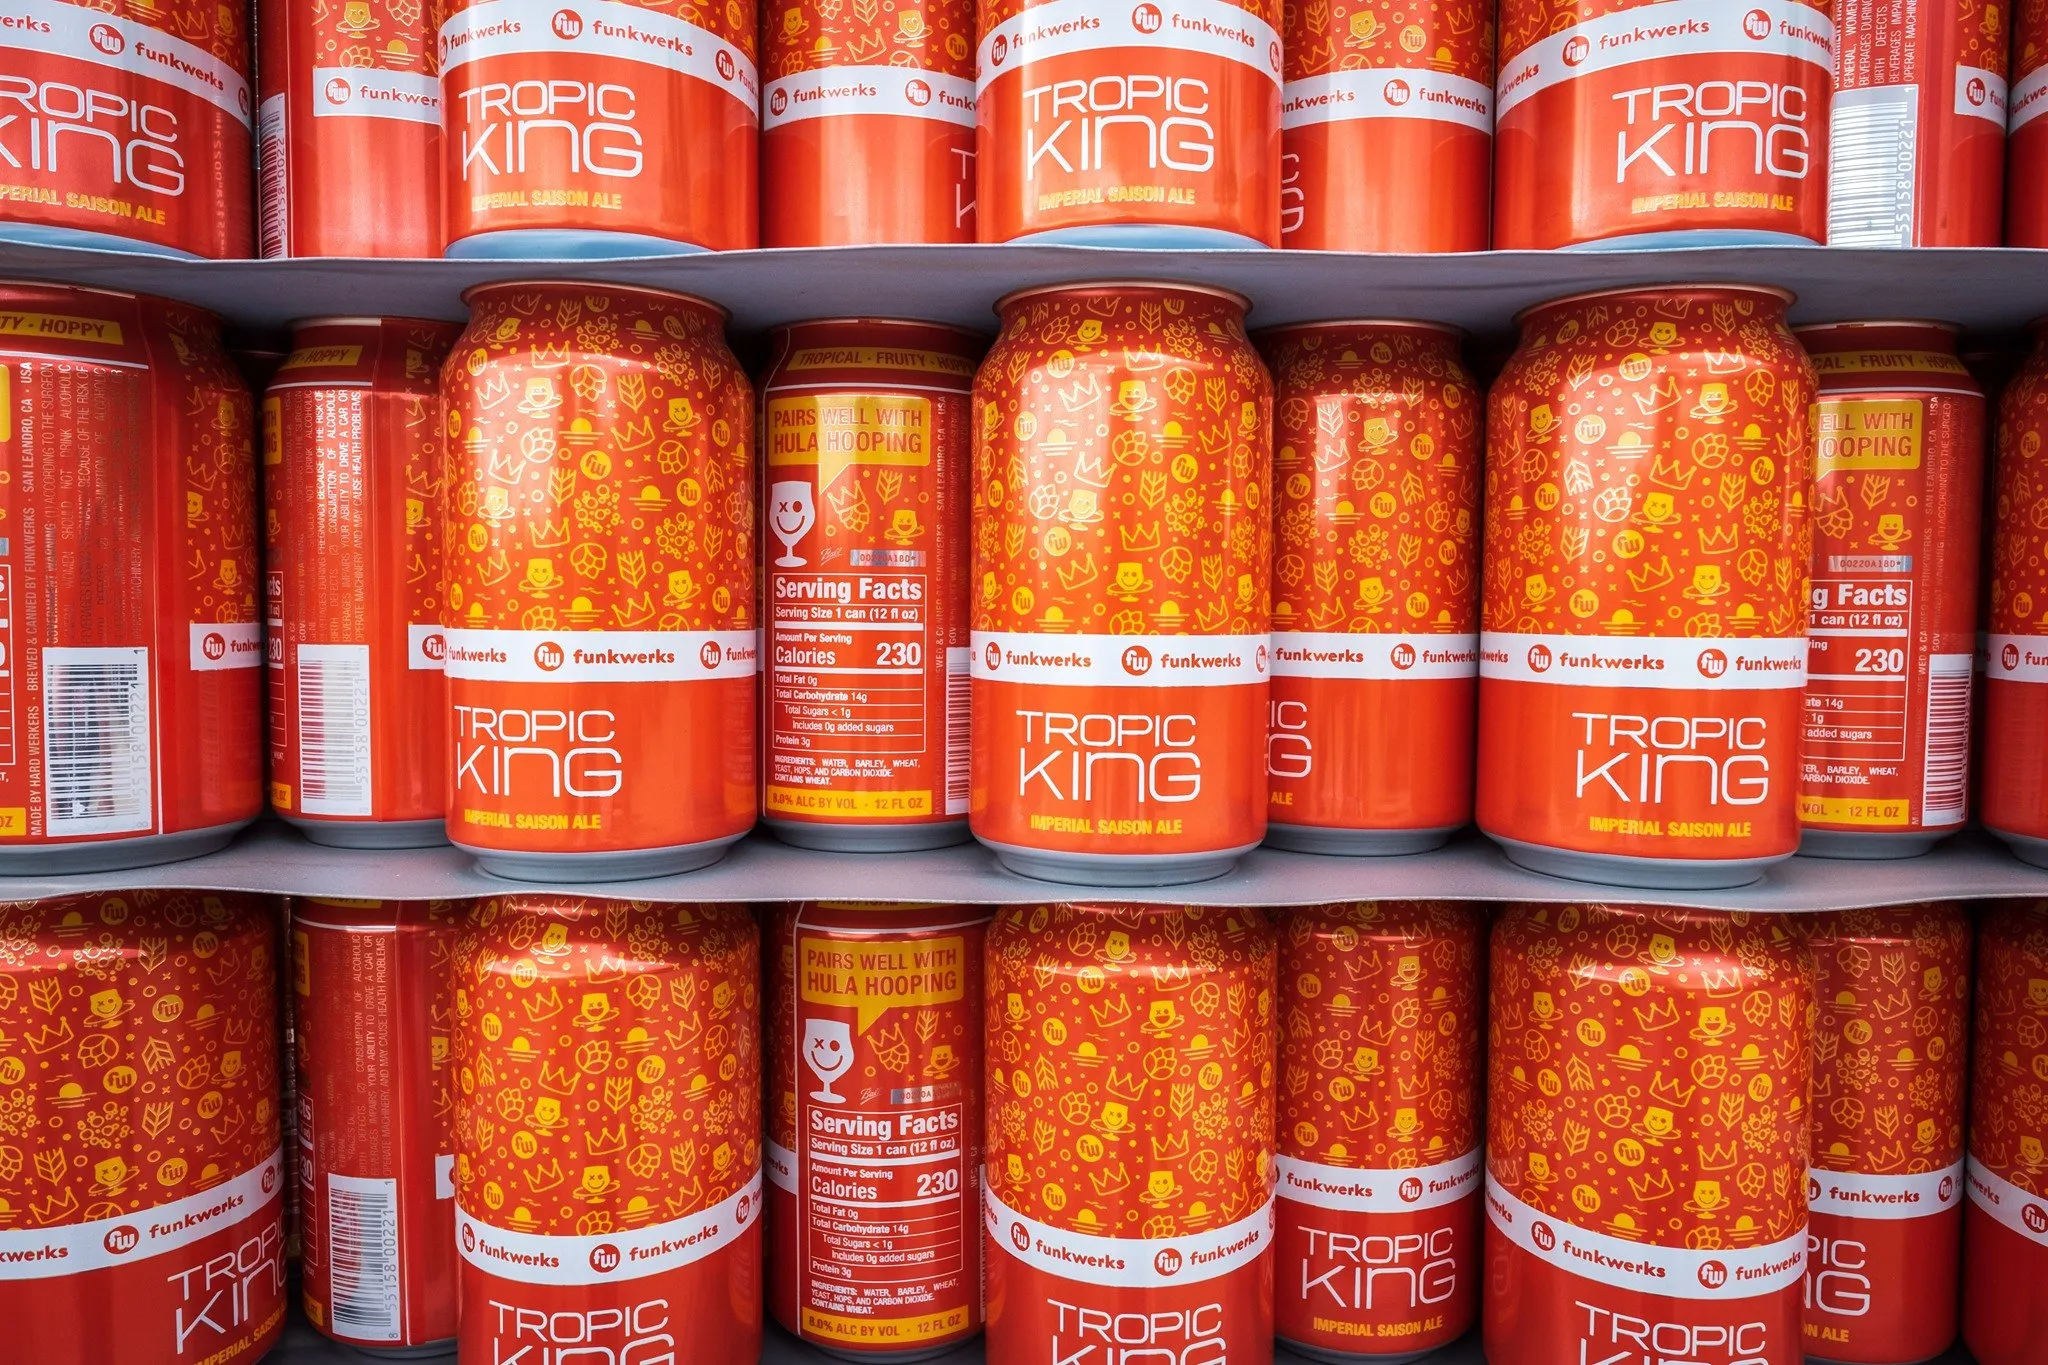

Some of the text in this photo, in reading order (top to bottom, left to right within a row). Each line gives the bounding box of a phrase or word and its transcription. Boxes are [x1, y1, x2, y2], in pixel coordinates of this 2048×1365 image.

[593, 20, 693, 56] funkwerks
[1171, 13, 1255, 47] funkwerks
[1599, 19, 1710, 50] funkwerks
[1874, 4, 1887, 83] BIRTH DEFECTS.
[135, 41, 224, 91] funkwerks
[1859, 34, 1871, 85] BEVERAGES
[1889, 30, 1901, 82] BEVERAGES
[1905, 42, 1915, 81] OPERATE
[459, 80, 635, 123] TROPIC
[793, 83, 877, 102] funkwerks
[1023, 75, 1208, 122] TROPIC
[1419, 88, 1487, 115] funkwerks
[1612, 81, 1806, 124] TROPIC
[800, 351, 925, 367] TROPICAL FRUITY
[1860, 355, 1914, 367] FRUITY
[774, 408, 922, 428] PAIRS WELL WITH
[1864, 413, 1913, 430] WITH
[774, 431, 922, 453] HULA HOOPING
[339, 442, 349, 467] DRIVE
[352, 442, 362, 475] HEALTH
[20, 362, 36, 572] FUNKWERKS SAN LEANDRO, CA USA
[776, 577, 922, 603] Serving Facts
[1838, 584, 1907, 606] Facts
[776, 606, 918, 621] Serving Size 1 can (12 fl oz)
[776, 633, 852, 644] Amount Per Serving
[573, 649, 675, 665] funkwerks
[776, 642, 921, 665] Calories 230
[1161, 653, 1241, 669] funkwerks
[1276, 648, 1364, 663] funkwerks
[1560, 653, 1664, 669] funkwerks
[1736, 655, 1801, 671] funkwerks
[1855, 649, 1903, 672] 230
[776, 674, 818, 686] Total Fat 0g
[776, 689, 867, 703] Total Carbohydrate 14g
[785, 705, 851, 718] Total Sugars 1g
[455, 706, 615, 742] TROPIC
[792, 720, 894, 733] Includes 0g added sugars
[1016, 710, 1196, 747] TROPIC
[1572, 713, 1766, 749] TROPIC
[1808, 729, 1872, 740] added sugars
[27, 647, 42, 835] MADE BY HARD WERKERS BREWED
[776, 735, 810, 747] Protein 3g
[775, 755, 920, 768] INGREDIENTS: WATER, BARLEY, WHEAT,
[775, 765, 793, 774] YEAST,
[815, 767, 829, 775] AND
[831, 768, 860, 777] CARBON
[862, 768, 894, 777] DIOXIDE.
[775, 774, 832, 785] CONTAINS WHEAT.
[773, 794, 923, 809] 8.0% ALC BY VOL 12 FL OZ
[1271, 793, 1293, 805] ALE
[516, 814, 601, 829] SAISON ALE
[1031, 815, 1182, 835] IMPERIAL SAISON ALE
[1590, 817, 1751, 837] IMPERIAL SAISON ALE
[807, 949, 957, 970] PAIRS WELL WITH
[376, 935, 386, 1017] HEALTH PROBLEMS.
[807, 971, 957, 996] HULA HOOPING
[352, 935, 365, 1072] CONSUMPTION ALCOHOLIC
[365, 985, 374, 1009] DRIVE
[811, 1110, 958, 1140] Serving Facts
[811, 1137, 906, 1156] Serving Size can
[812, 1168, 958, 1200] Calories 230
[1287, 1173, 1373, 1198] funkwerks
[1829, 1187, 1920, 1203] funkwerks
[150, 1193, 244, 1238] funkwerks
[832, 1220, 890, 1235] Carbohydrate
[479, 1223, 718, 1268] funkwerks funkwerks
[832, 1249, 934, 1263] Includes sugars
[1035, 1230, 1259, 1270] funkwerks funkwerks
[1298, 1226, 1453, 1264] TROPIC
[813, 1261, 840, 1275] Protein
[1563, 1240, 1801, 1281] funkwerks funkwerks
[489, 1299, 669, 1343] TROPIC
[1047, 1299, 1222, 1344] TROPIC
[1313, 1316, 1443, 1337] IMPERIAL SAISON ALE
[1575, 1301, 1766, 1356] TROPIC
